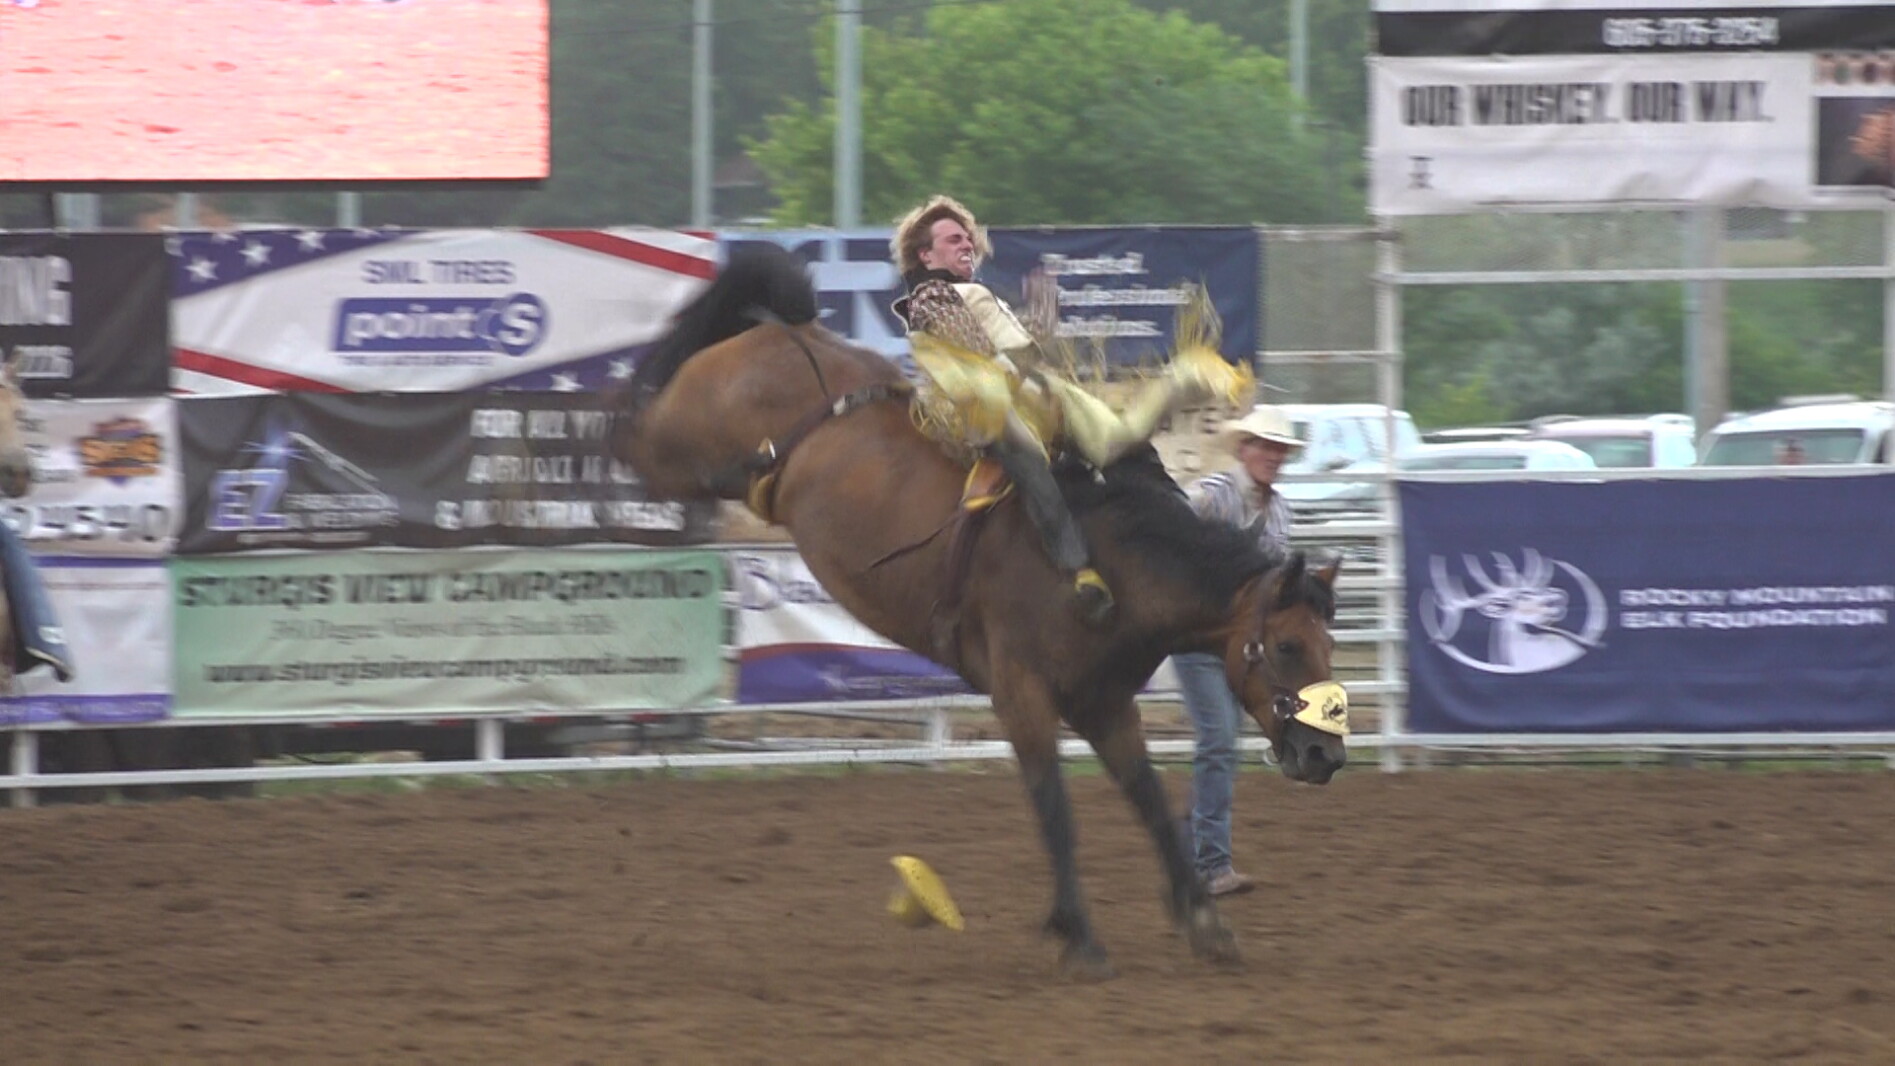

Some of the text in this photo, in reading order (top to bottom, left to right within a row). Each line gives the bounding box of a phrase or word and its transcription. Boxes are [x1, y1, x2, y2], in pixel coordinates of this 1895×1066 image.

[1400, 81, 1774, 126] OUR WHISKEY. OUR WAY.
[429, 260, 517, 285] TIRES
[343, 301, 542, 348] point S
[470, 410, 524, 439] FOR
[527, 410, 568, 438] ALL
[207, 469, 288, 531] EZ
[434, 500, 462, 530] &
[180, 570, 714, 610] STURGIS VIEW CAMPGROUND
[1620, 583, 1894, 607] ROCKY MOUNTAIN
[1620, 608, 1888, 630] ELK FOUNDATION
